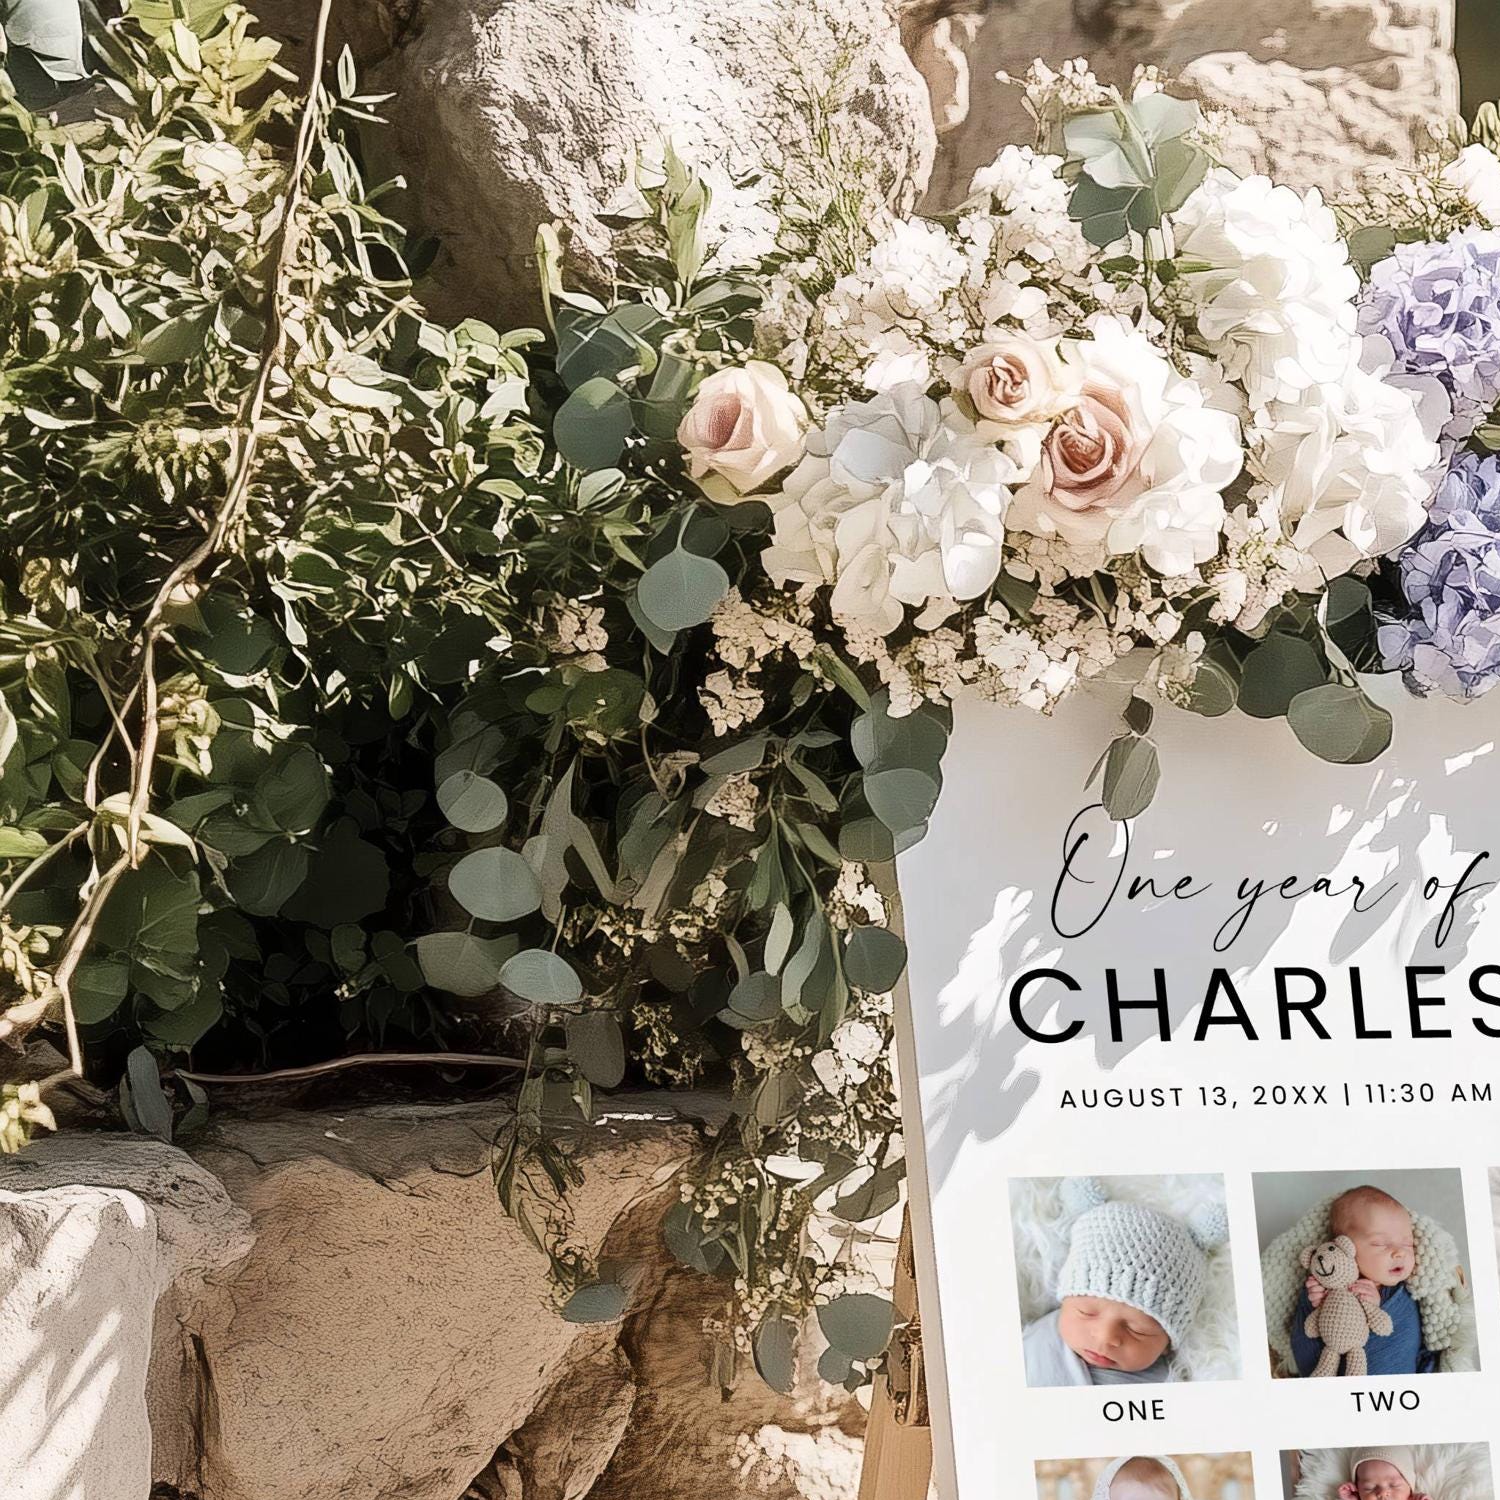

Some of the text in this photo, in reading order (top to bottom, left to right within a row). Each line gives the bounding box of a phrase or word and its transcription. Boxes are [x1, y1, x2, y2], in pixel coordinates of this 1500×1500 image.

[1050, 803, 1497, 952] One year of
[1060, 1087, 1183, 1109] AUGUST
[1199, 1086, 1237, 1109] 13,
[1252, 1085, 1328, 1105] 20XX
[1365, 1083, 1434, 1103] 11:30
[1451, 1083, 1492, 1102] AM
[1102, 1399, 1165, 1422] ONE
[1350, 1390, 1420, 1412] TWO
